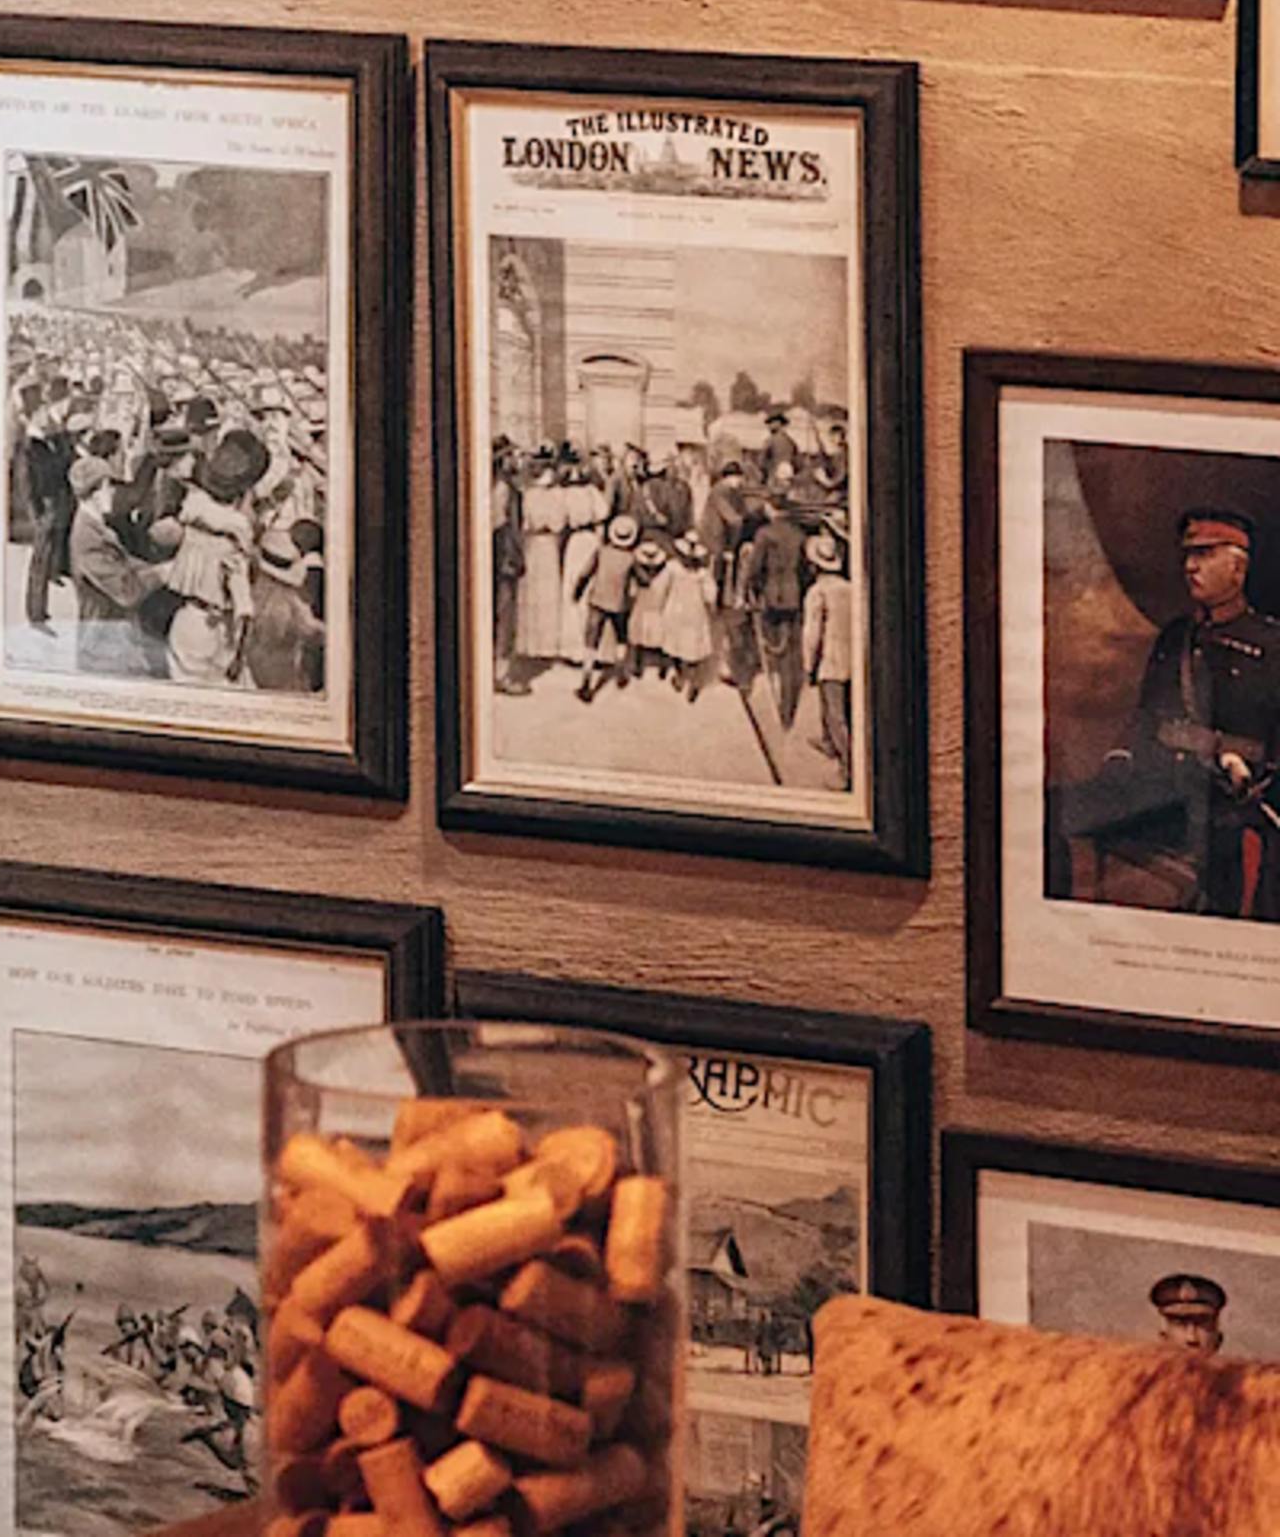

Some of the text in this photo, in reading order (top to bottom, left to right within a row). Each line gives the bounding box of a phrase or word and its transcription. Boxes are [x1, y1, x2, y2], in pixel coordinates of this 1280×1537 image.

[565, 110, 770, 146] THE ILLUSTRATED
[501, 135, 828, 186] LONDON NEWS.
